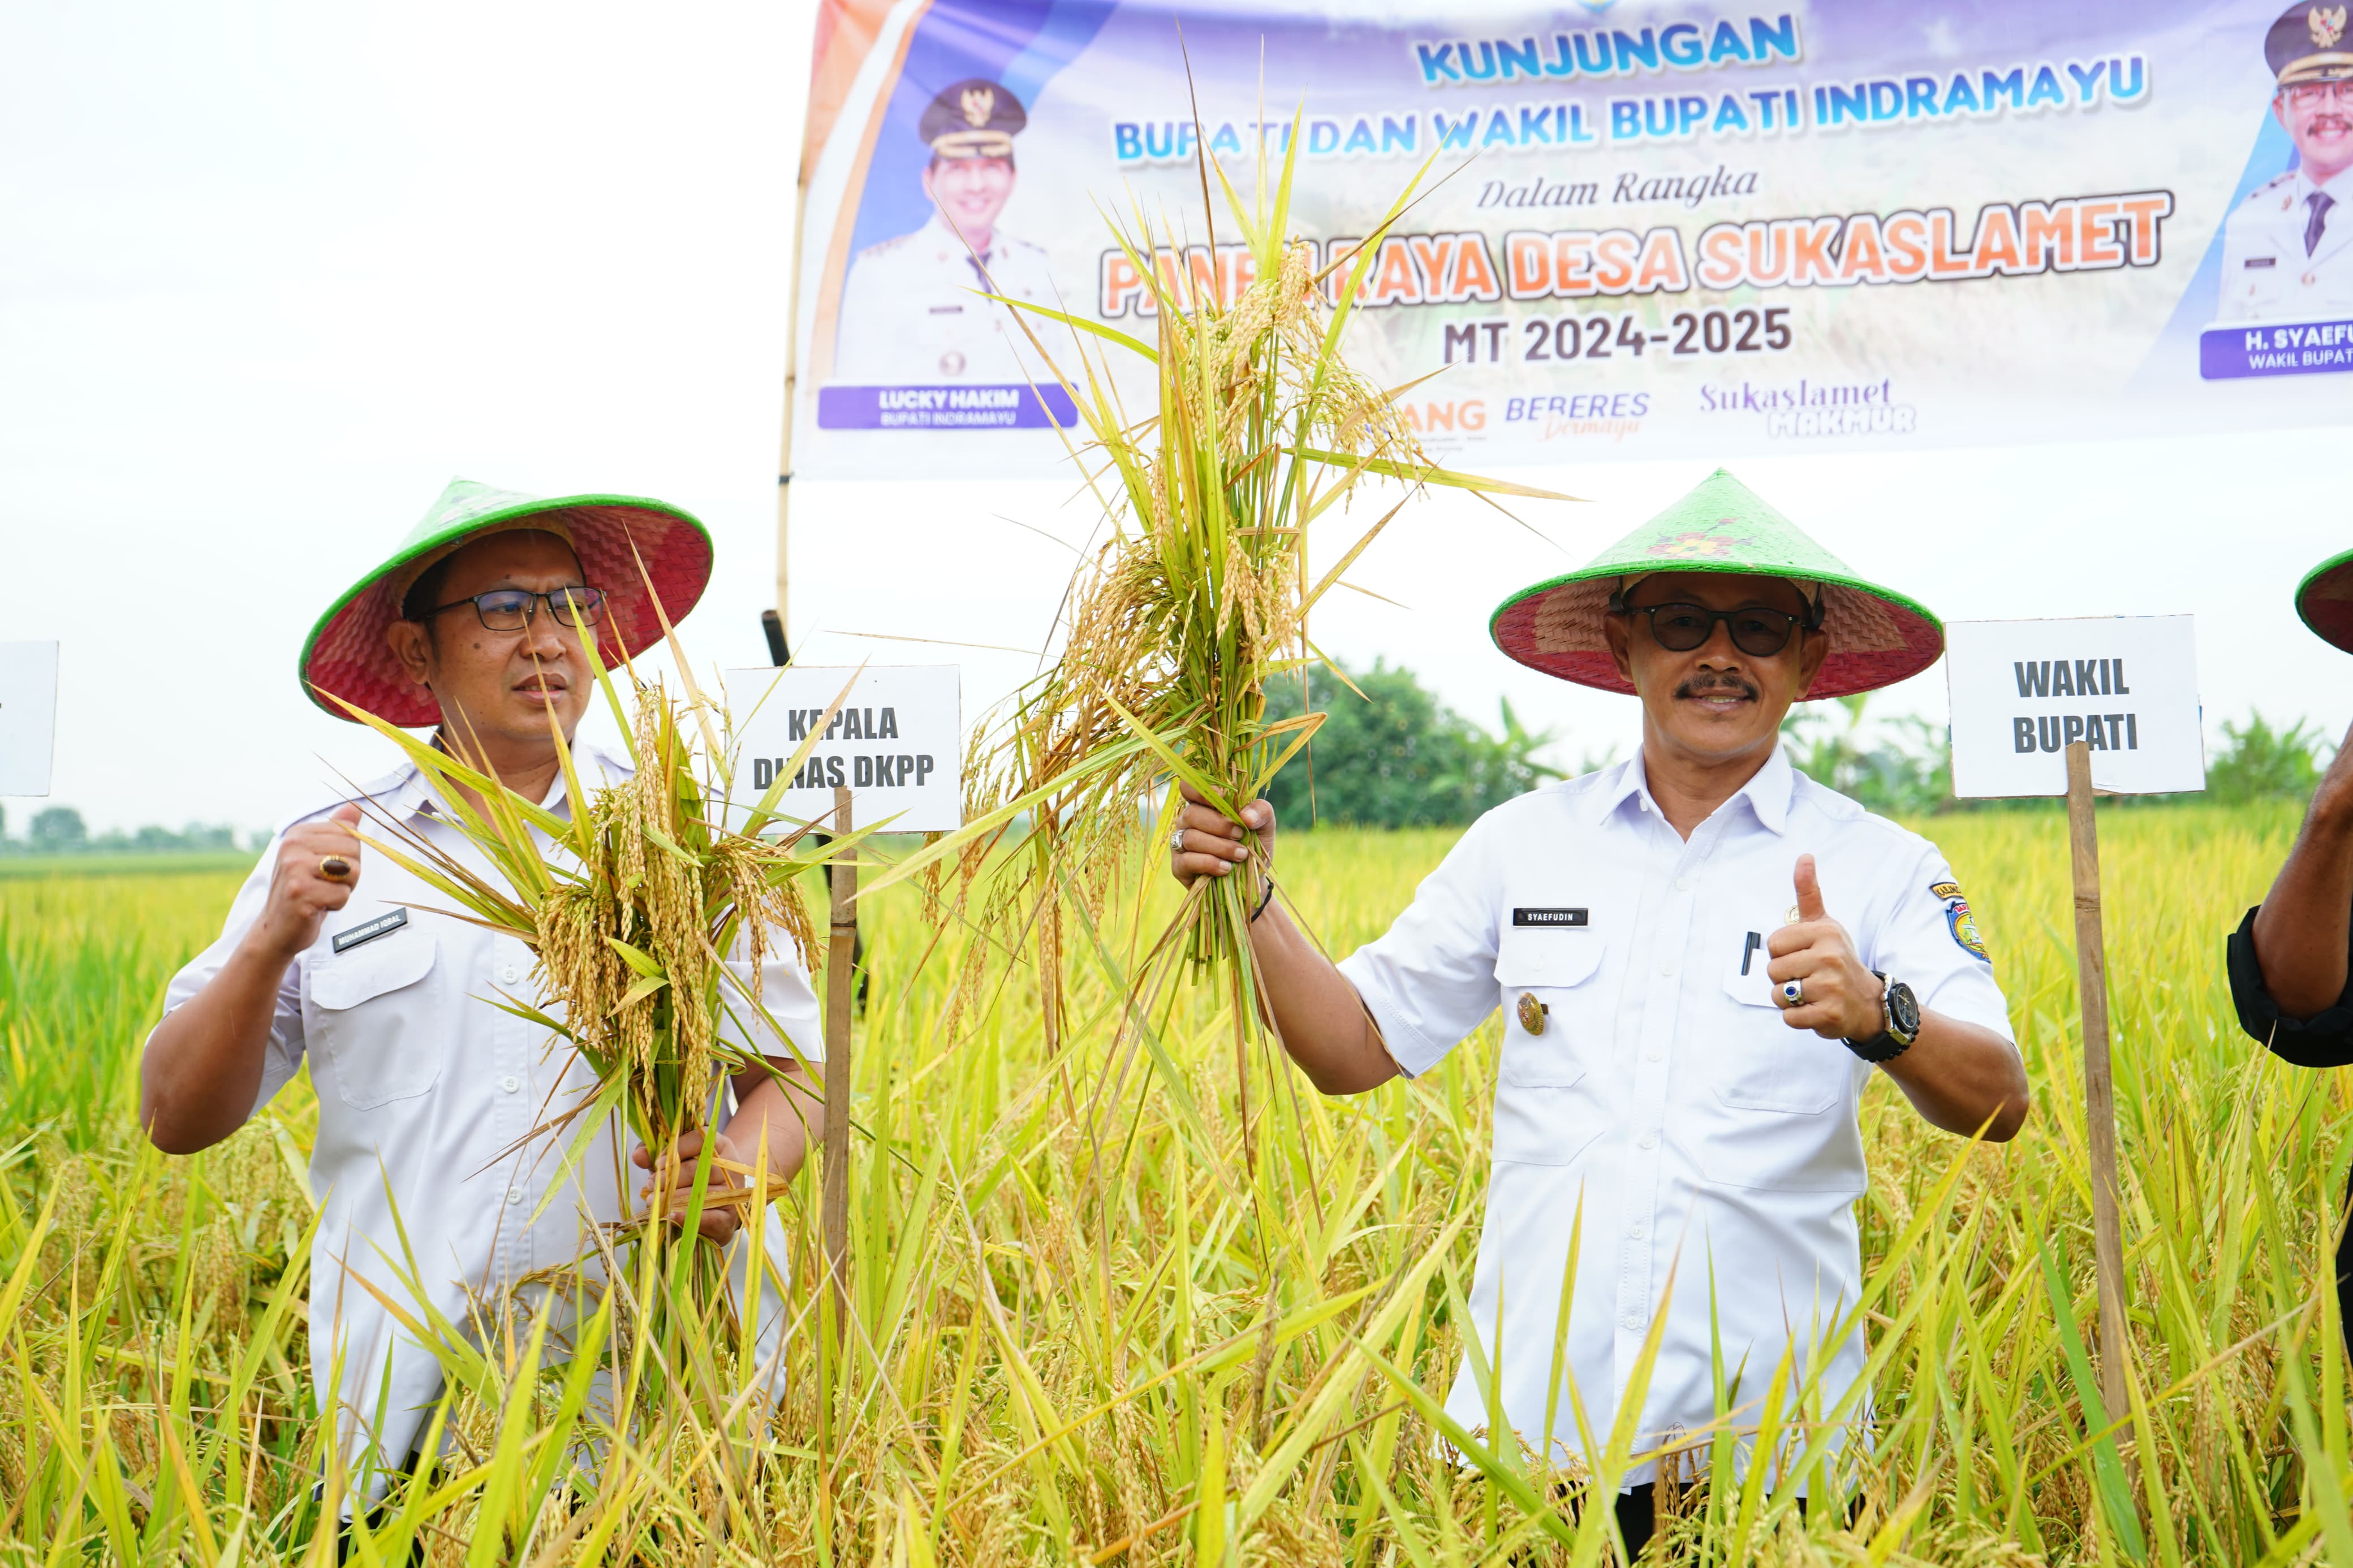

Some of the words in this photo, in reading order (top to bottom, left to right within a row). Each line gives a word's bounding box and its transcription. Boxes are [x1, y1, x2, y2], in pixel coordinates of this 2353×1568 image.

[1417, 14, 1796, 83] KUNJUNGAN
[1115, 122, 1293, 160] BUPATI
[1308, 115, 1416, 154] DAN
[1433, 102, 1593, 151] WAKIL
[1611, 90, 1799, 140] BUPATI
[1814, 57, 2144, 125] INDRAMAYU
[1477, 176, 1597, 209] Dalam
[1613, 165, 1759, 208] Rangka
[1334, 236, 1497, 301] RAYA
[1510, 228, 1683, 295] DESA
[1701, 198, 2165, 284] SUKASLAMET
[1444, 322, 1509, 365] MT
[1525, 308, 1792, 362] 2024-2025
[2245, 330, 2269, 351] H.
[2249, 352, 2299, 369] WAKIL
[878, 390, 948, 409] LUCKY
[949, 389, 1020, 408] HAKIM
[1700, 378, 1890, 412] Sukaslamet
[881, 412, 930, 426] BUPATI
[932, 411, 1017, 425] INDRAMAYU
[1768, 404, 1917, 438] MAKMUR
[2014, 658, 2130, 698] WAKIL
[2013, 714, 2137, 754] BUPATI
[854, 754, 934, 788] DKPP
[338, 923, 380, 945] MUHAMMAD
[380, 914, 401, 928] IQBAL
